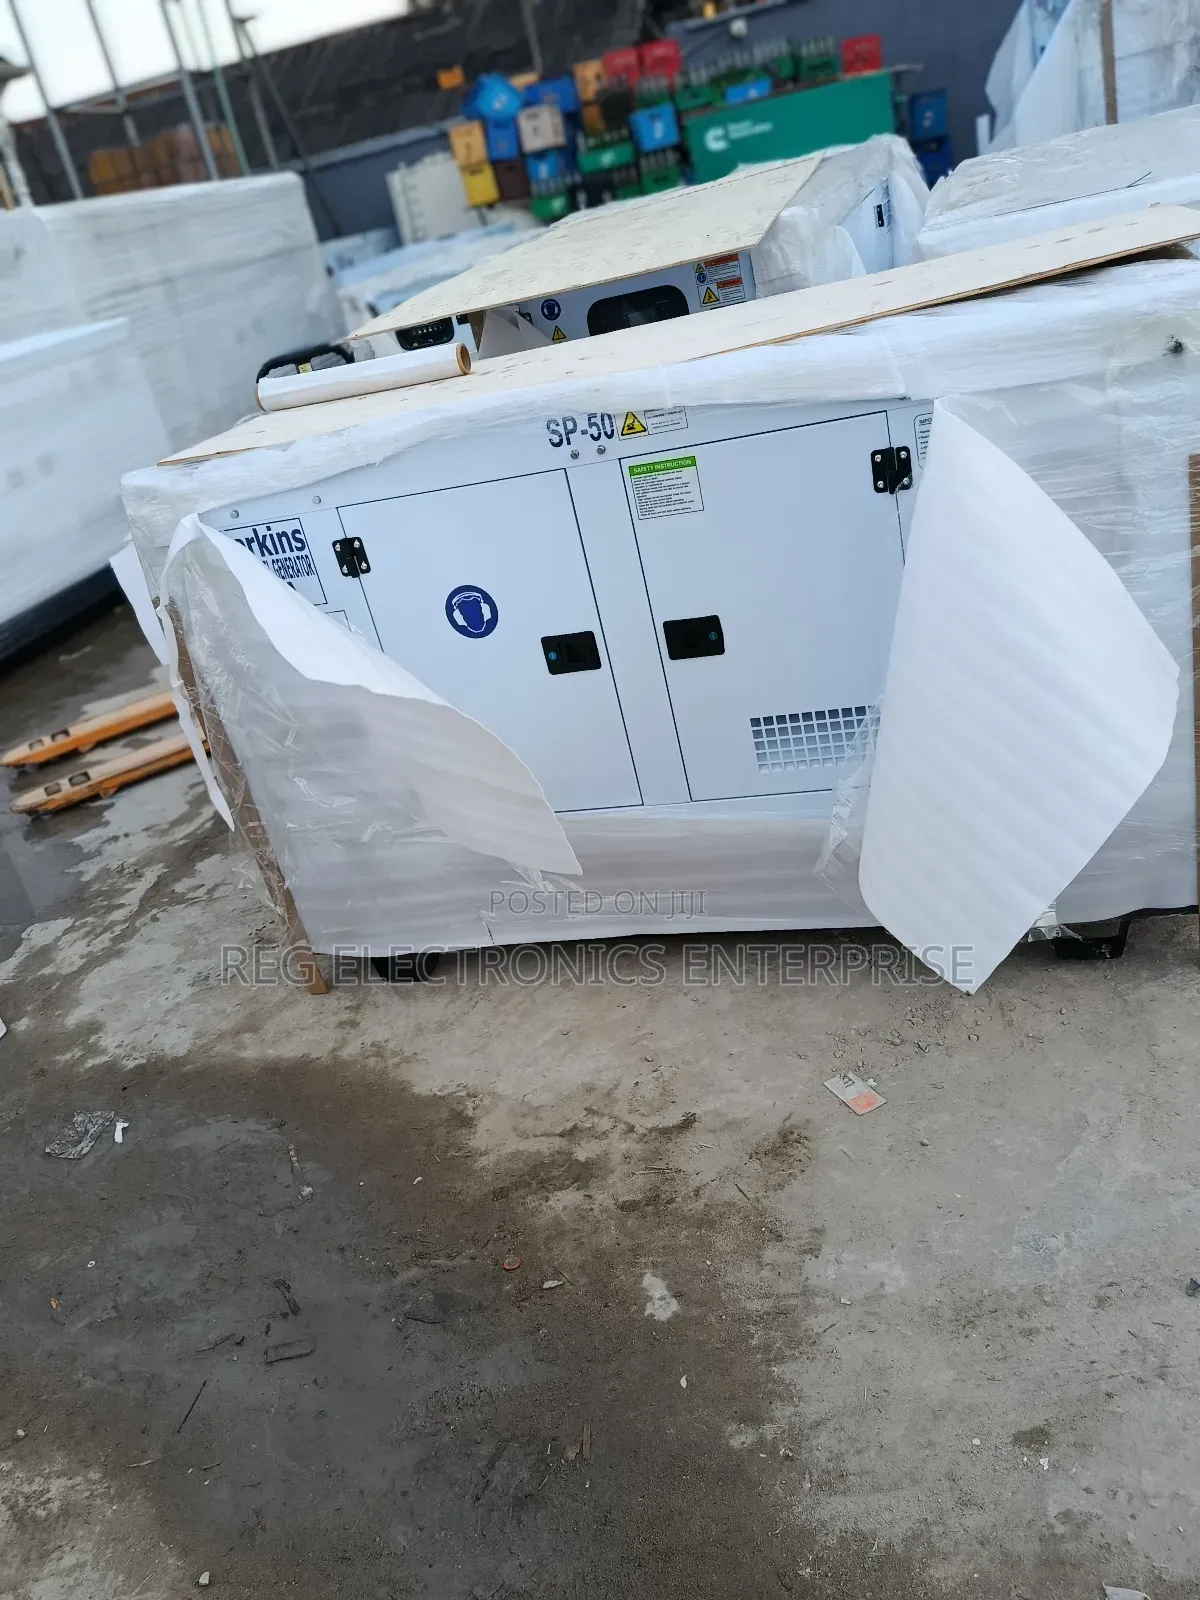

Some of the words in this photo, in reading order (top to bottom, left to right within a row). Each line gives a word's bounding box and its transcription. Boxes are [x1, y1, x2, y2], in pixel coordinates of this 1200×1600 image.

[546, 412, 615, 447] SP-50
[633, 465, 654, 473] SAFETY
[654, 459, 693, 470] INSTRUCTION
[272, 554, 316, 580] GENERATOR
